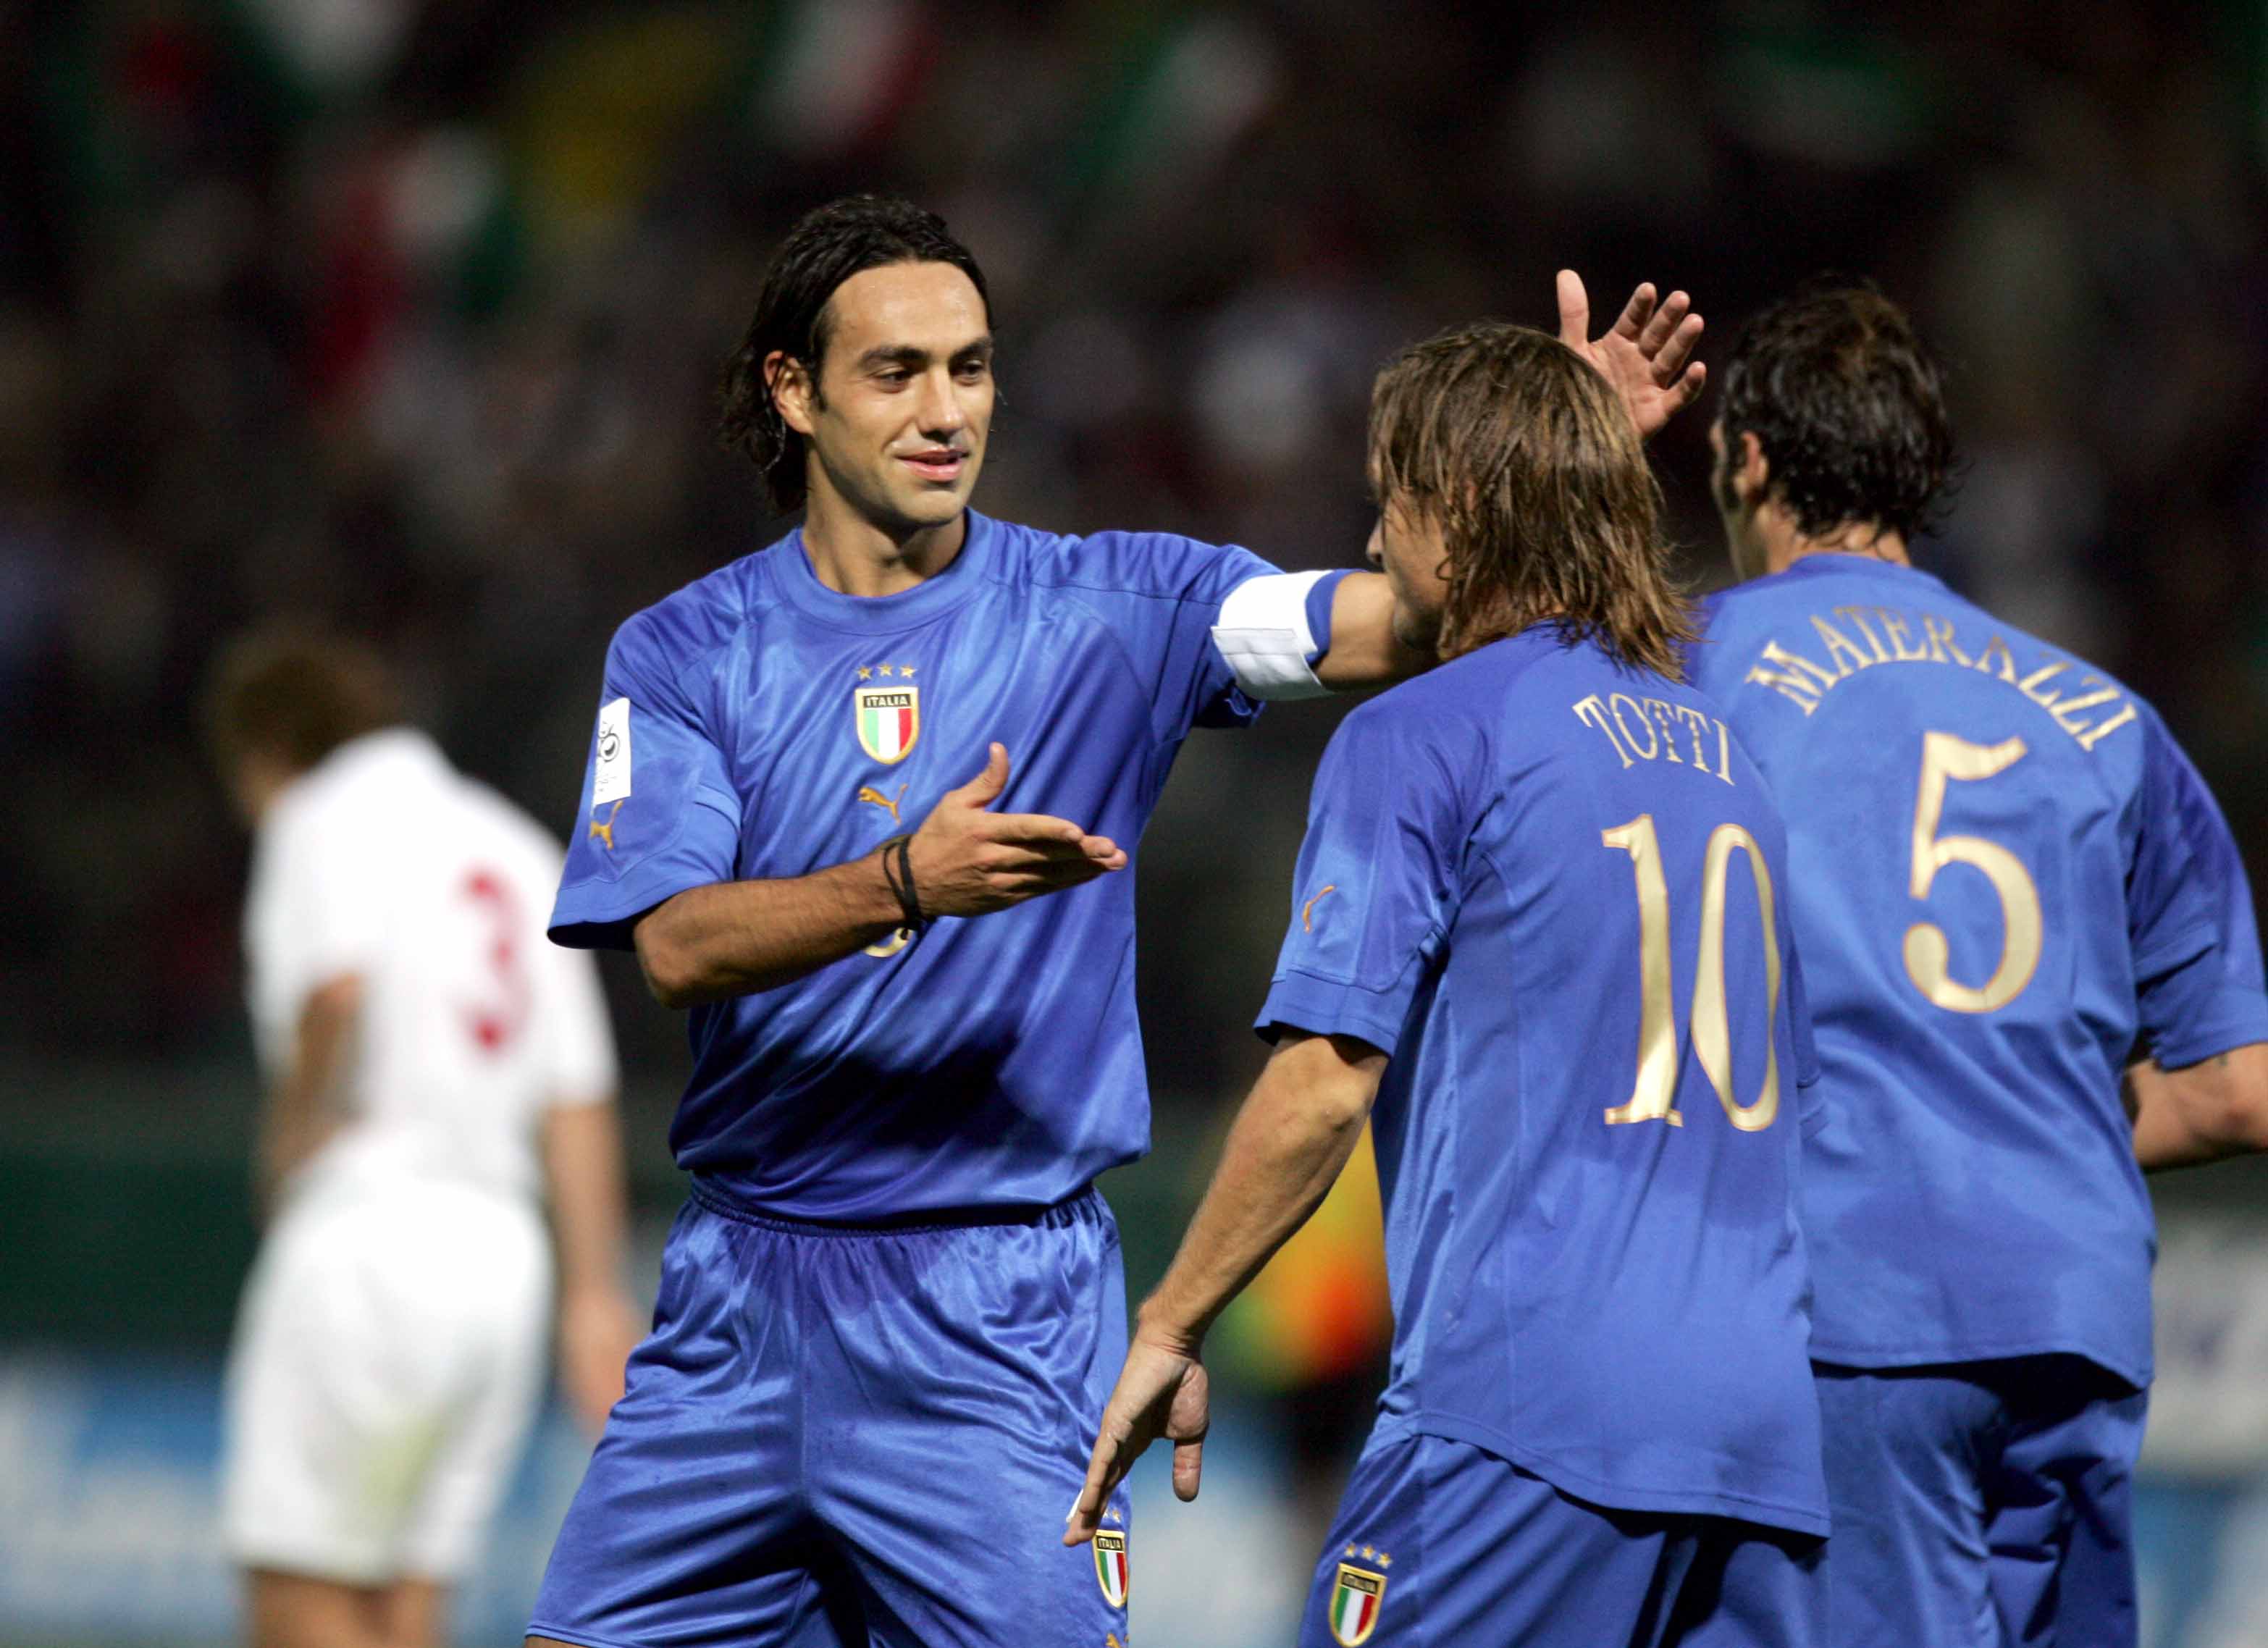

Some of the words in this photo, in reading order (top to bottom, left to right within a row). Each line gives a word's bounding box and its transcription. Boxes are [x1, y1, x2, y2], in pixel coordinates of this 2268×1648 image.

[866, 696, 908, 707] ITALIA
[1744, 605, 2136, 752] MATERAZZI
[1573, 693, 1735, 786] TOTTI
[1903, 731, 2043, 1013] 5
[1601, 814, 1781, 1132] 10
[1098, 1537, 1121, 1550] ITALIA
